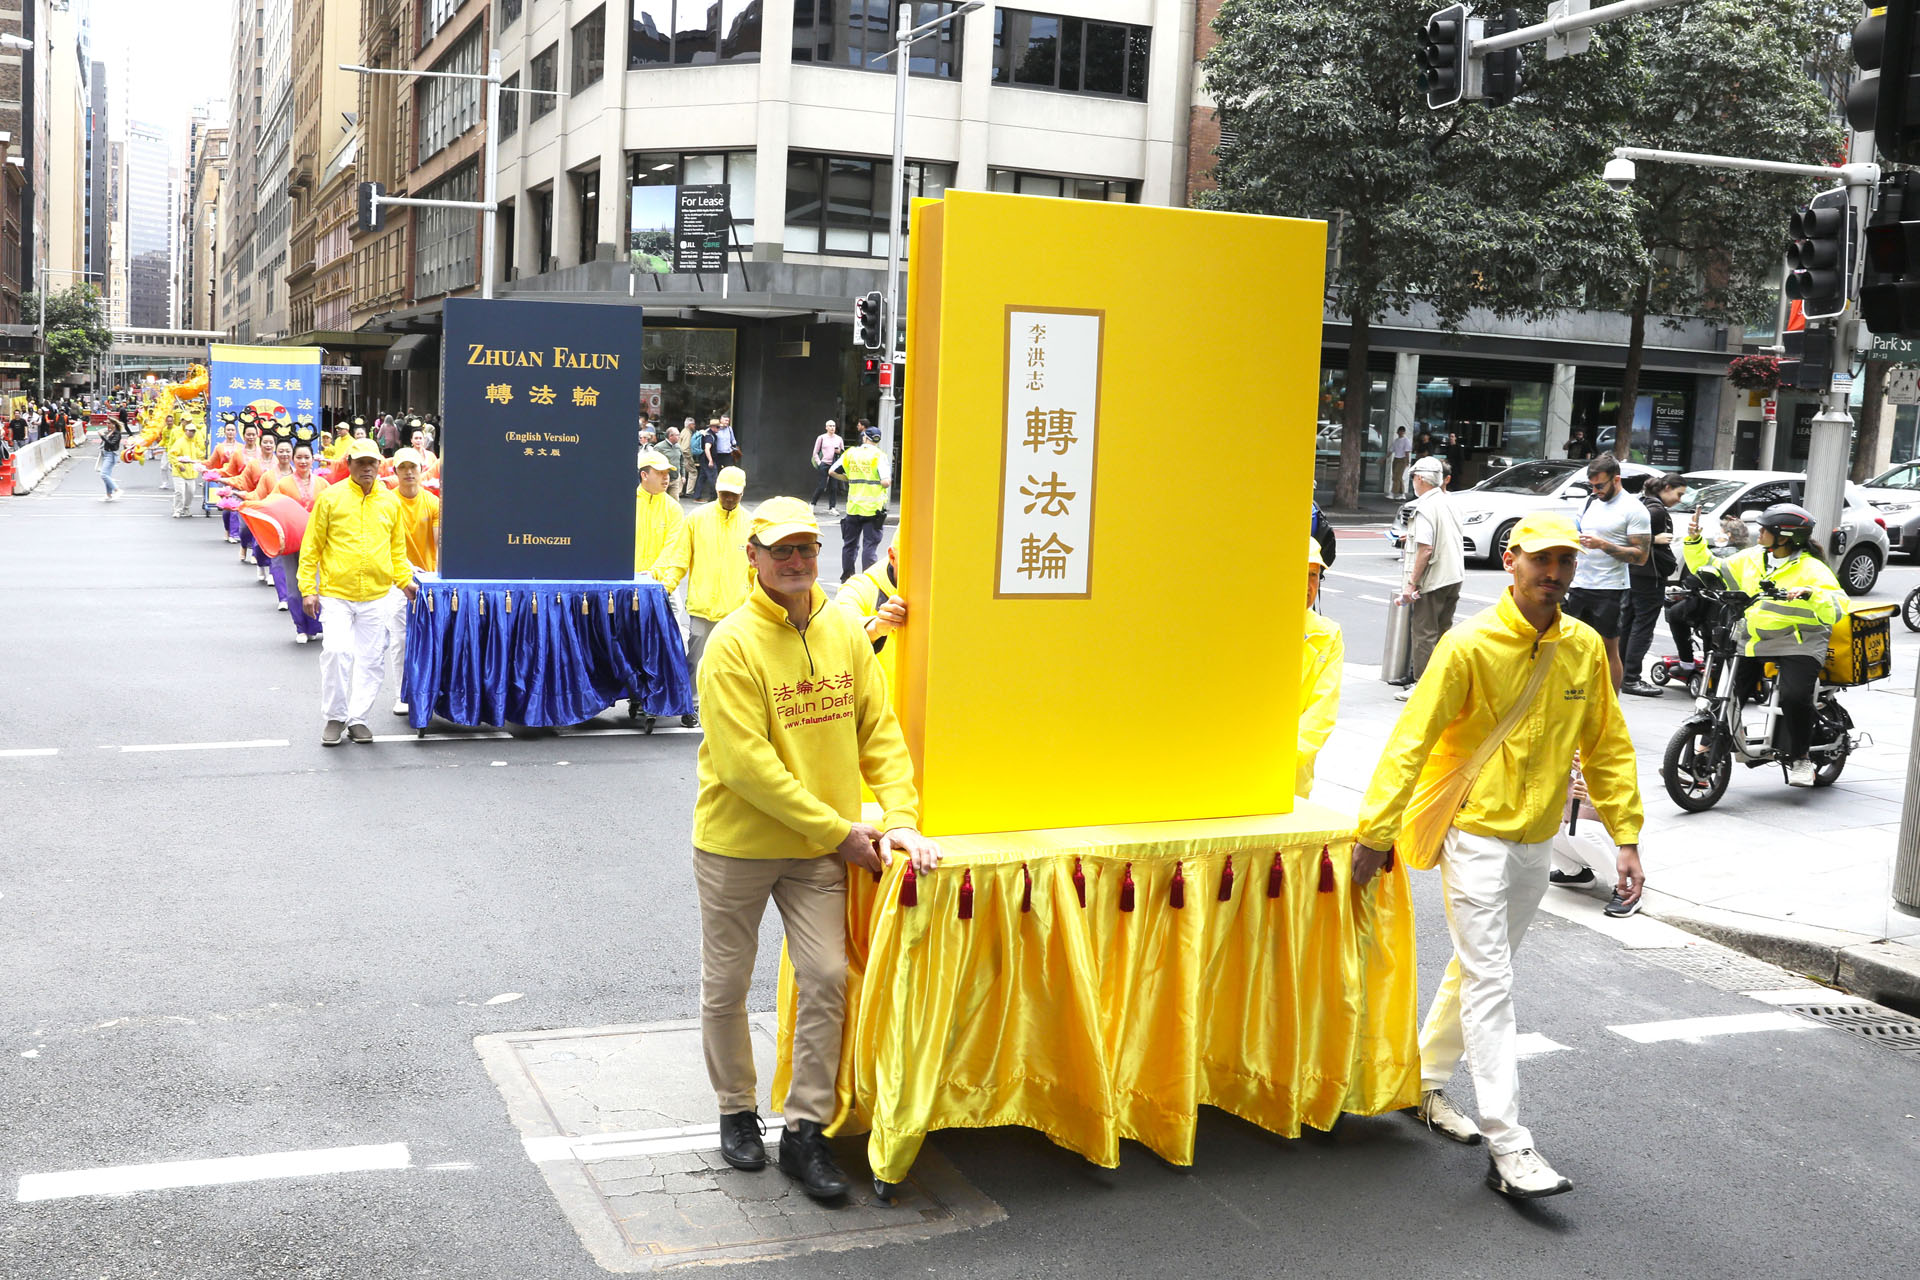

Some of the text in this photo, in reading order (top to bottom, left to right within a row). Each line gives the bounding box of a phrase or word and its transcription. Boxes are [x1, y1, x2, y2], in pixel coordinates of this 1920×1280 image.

[681, 196, 724, 207] For Lease
[1873, 335, 1912, 351] Park St
[467, 344, 544, 367] ZHUAN
[553, 346, 620, 370] FALUN
[1025, 323, 1047, 391] 李洪志
[485, 383, 601, 407] 轉法輪
[1667, 407, 1685, 416] Lease
[1800, 417, 1812, 425] FO
[505, 431, 580, 444] (English Version)
[523, 447, 561, 457] 英文版
[1016, 405, 1079, 581] 轉法輪
[522, 534, 571, 545] HONGZHI
[773, 670, 854, 703] 法輪大法
[776, 692, 854, 720] Falun Dafa
